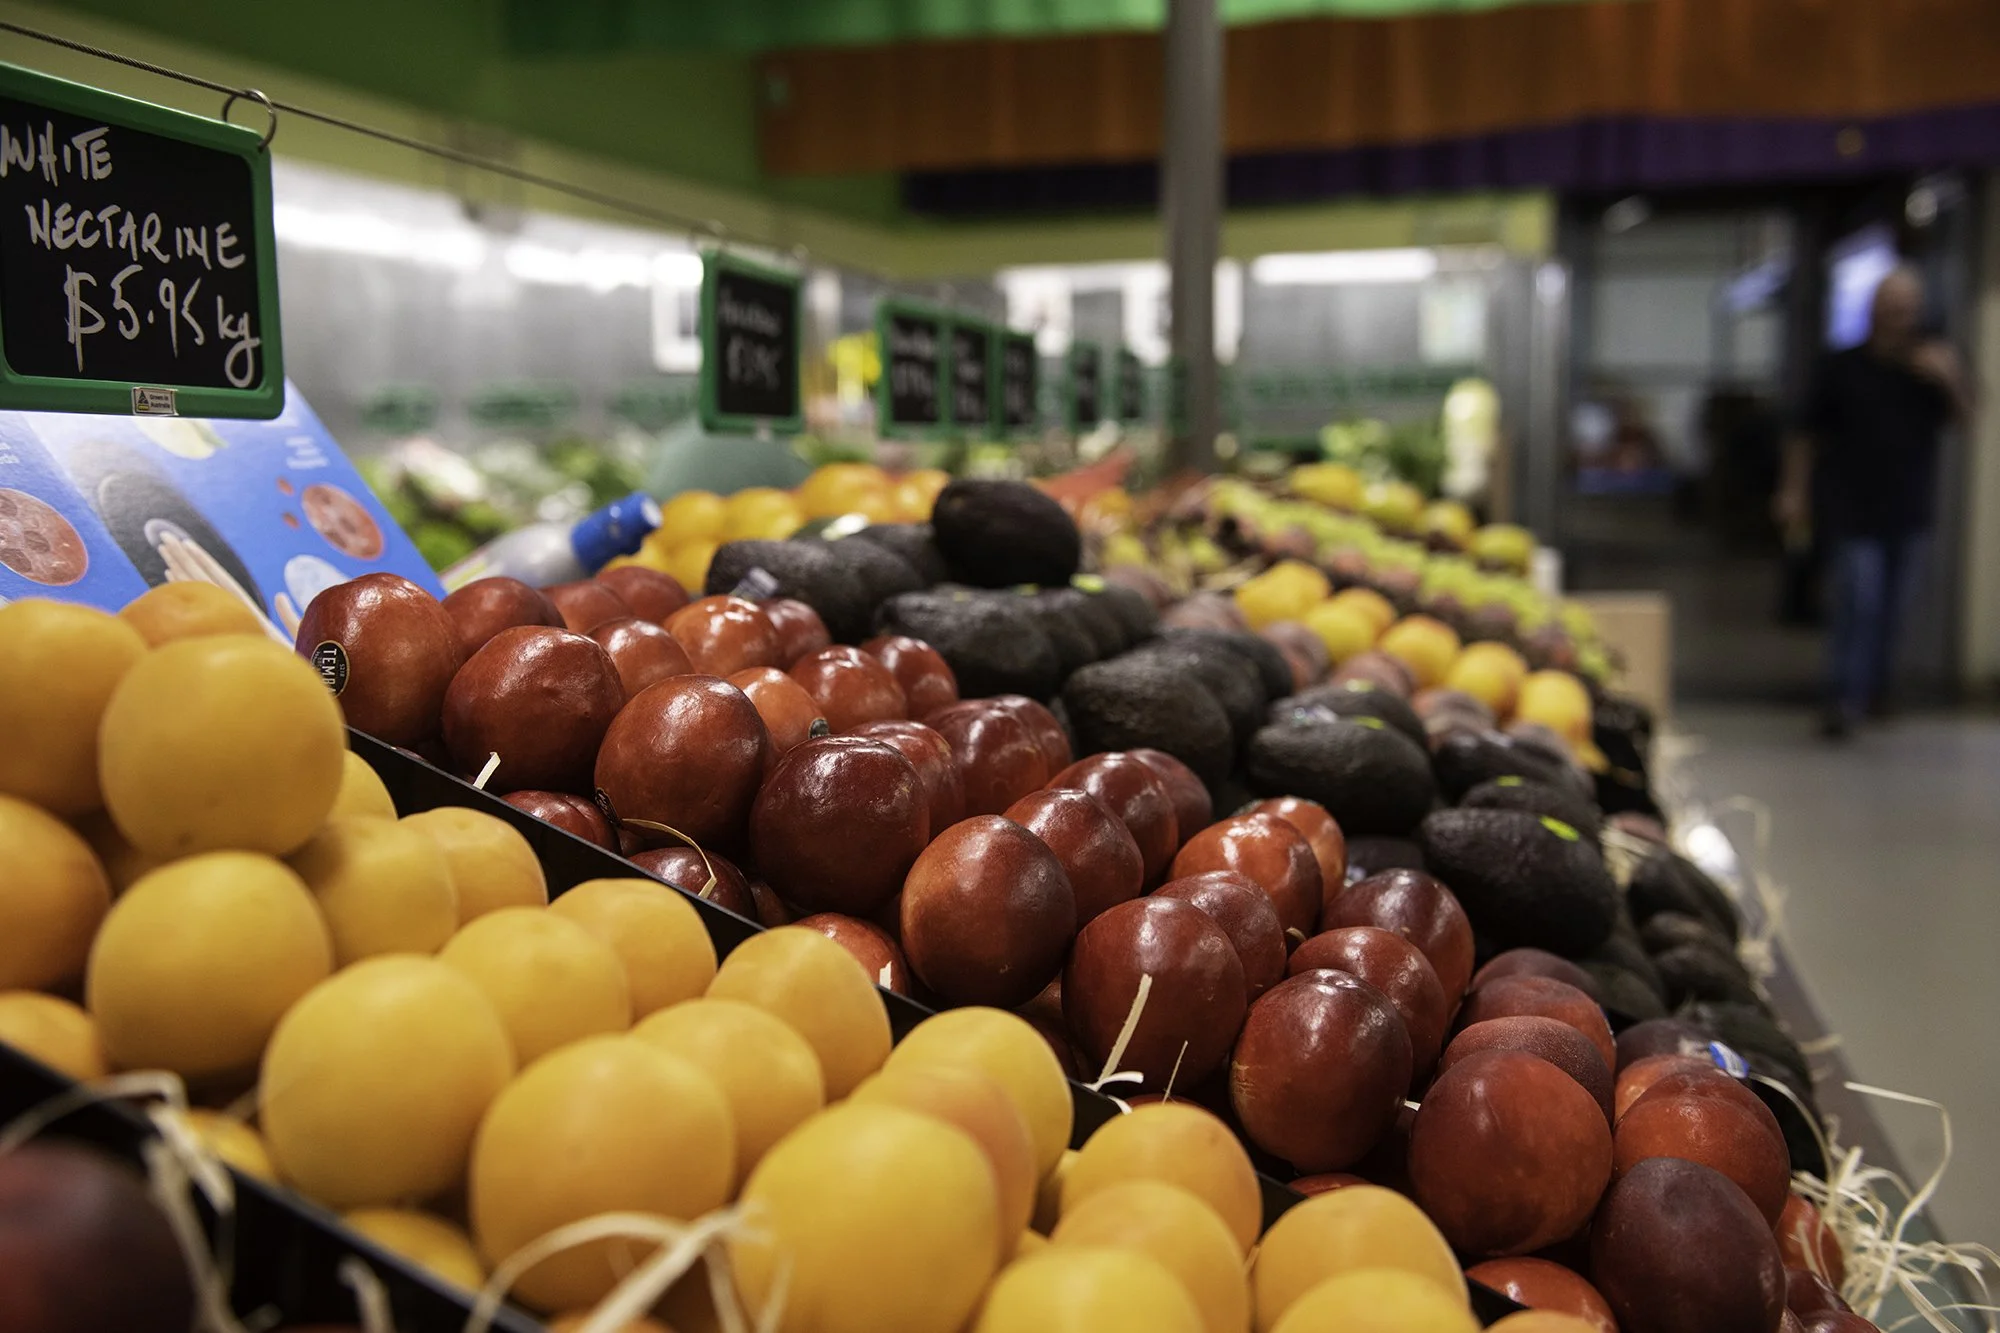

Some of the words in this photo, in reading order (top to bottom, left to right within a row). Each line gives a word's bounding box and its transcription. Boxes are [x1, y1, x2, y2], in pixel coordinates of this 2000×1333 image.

[0, 120, 112, 187] WHITE
[25, 199, 245, 270] NECTARINE
[64, 264, 205, 372] $5.95
[216, 296, 261, 388] kg
